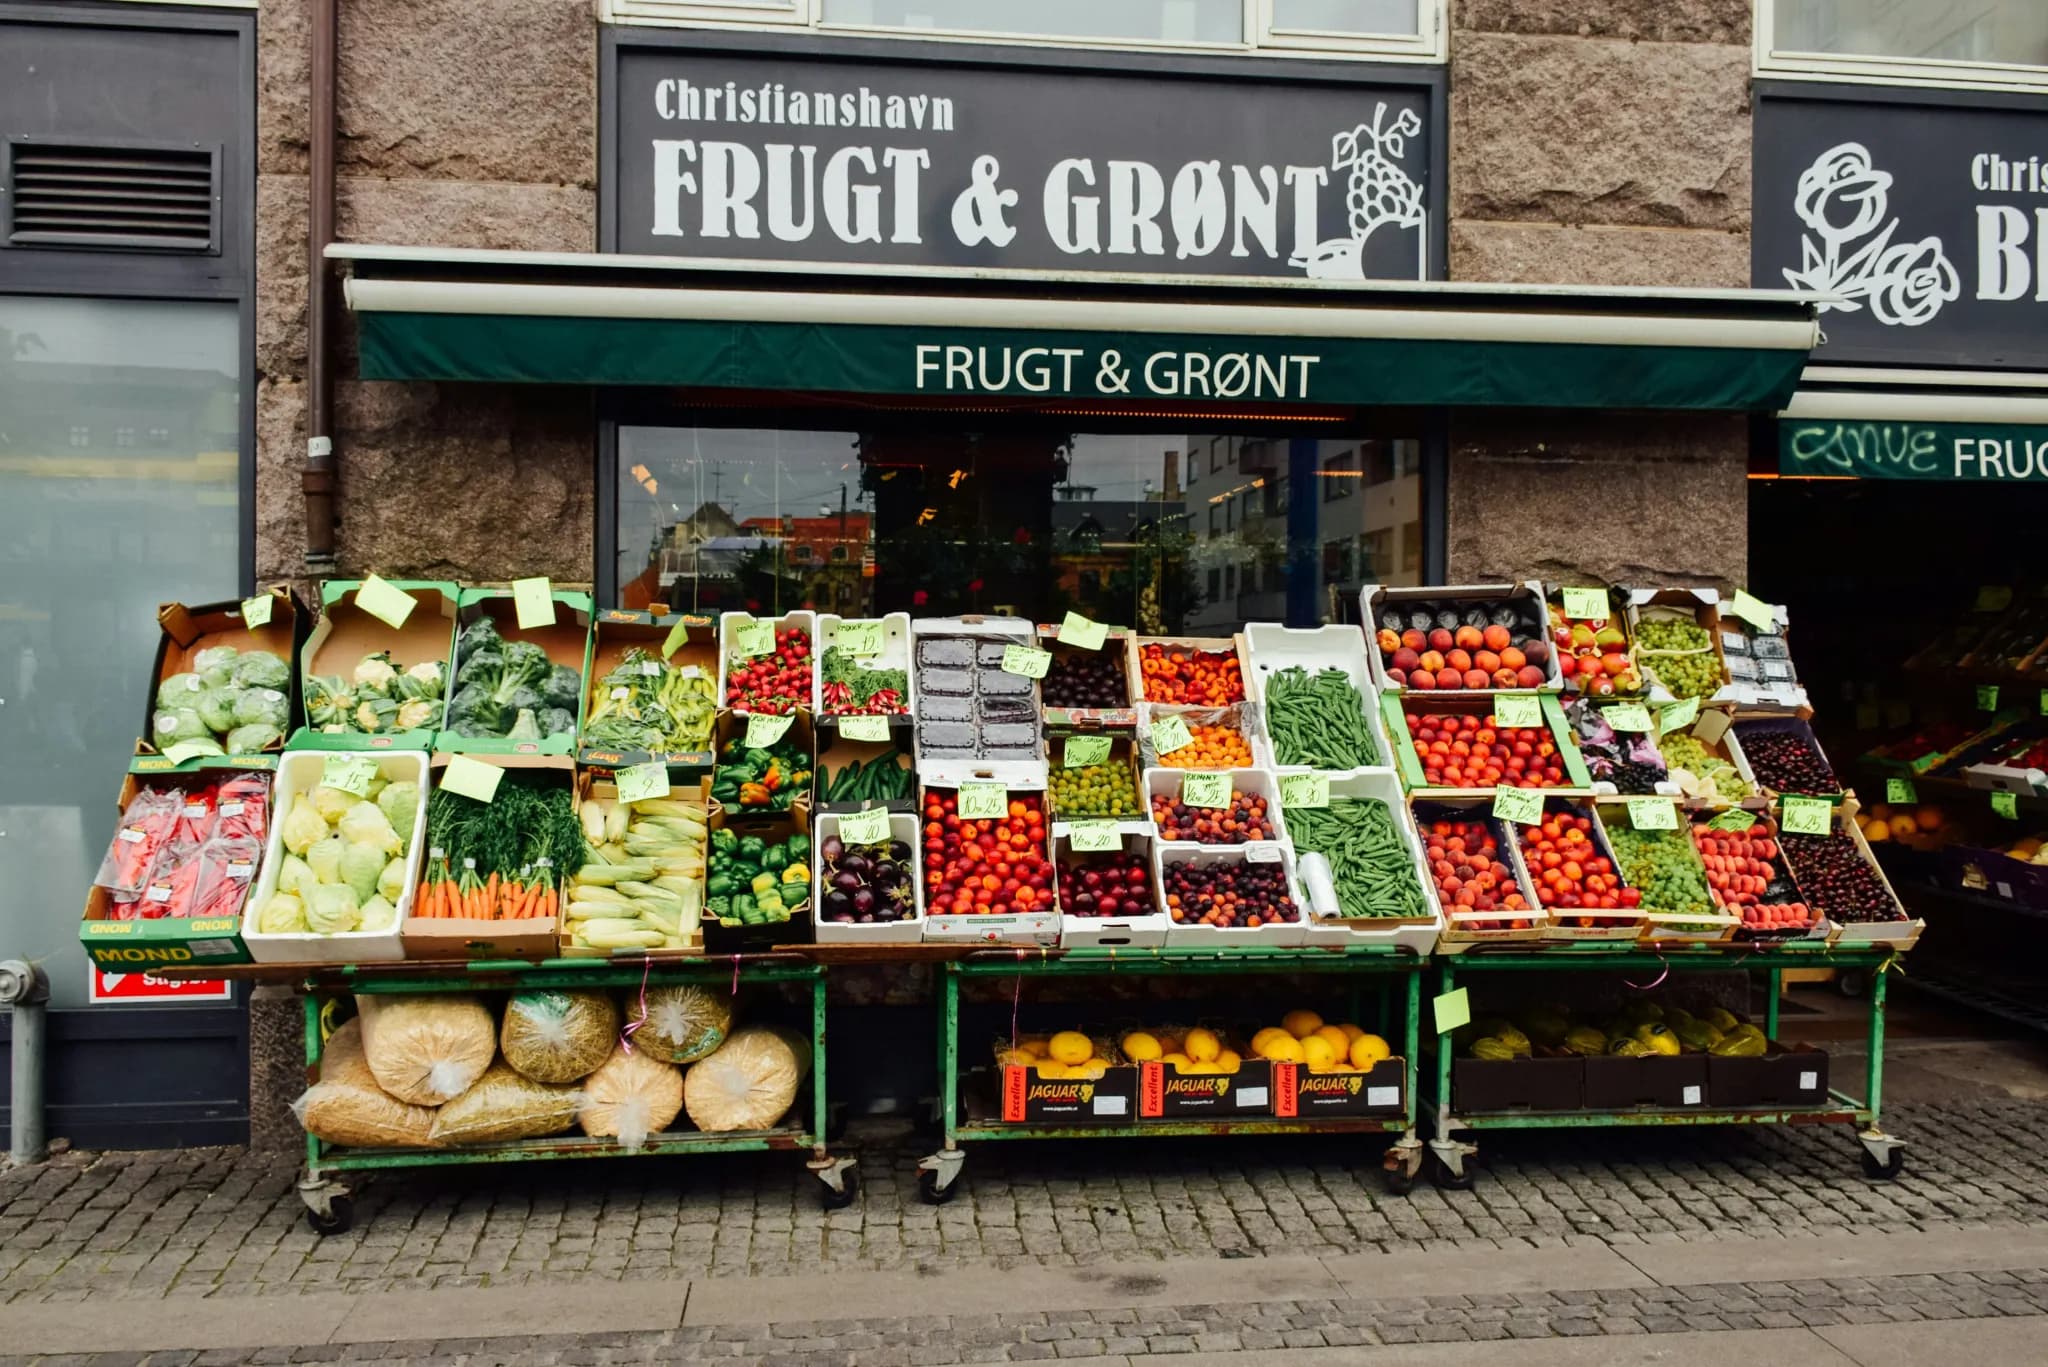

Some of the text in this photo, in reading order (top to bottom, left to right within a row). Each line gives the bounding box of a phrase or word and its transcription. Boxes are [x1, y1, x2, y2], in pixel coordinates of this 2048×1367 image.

[655, 78, 954, 131] Christianshavn
[651, 139, 1329, 266] FRUGT & GRØNT
[916, 344, 1321, 398] FRUGT & GRØNT
[94, 947, 192, 962] MOND
[1010, 1070, 1021, 1118] Excellent
[1027, 1084, 1080, 1101] JAGUAR
[1147, 1065, 1158, 1112] Excellent
[1164, 1079, 1215, 1095] JAGUAR
[1281, 1064, 1292, 1112] Excellent
[1298, 1077, 1349, 1095] JAGUAR
